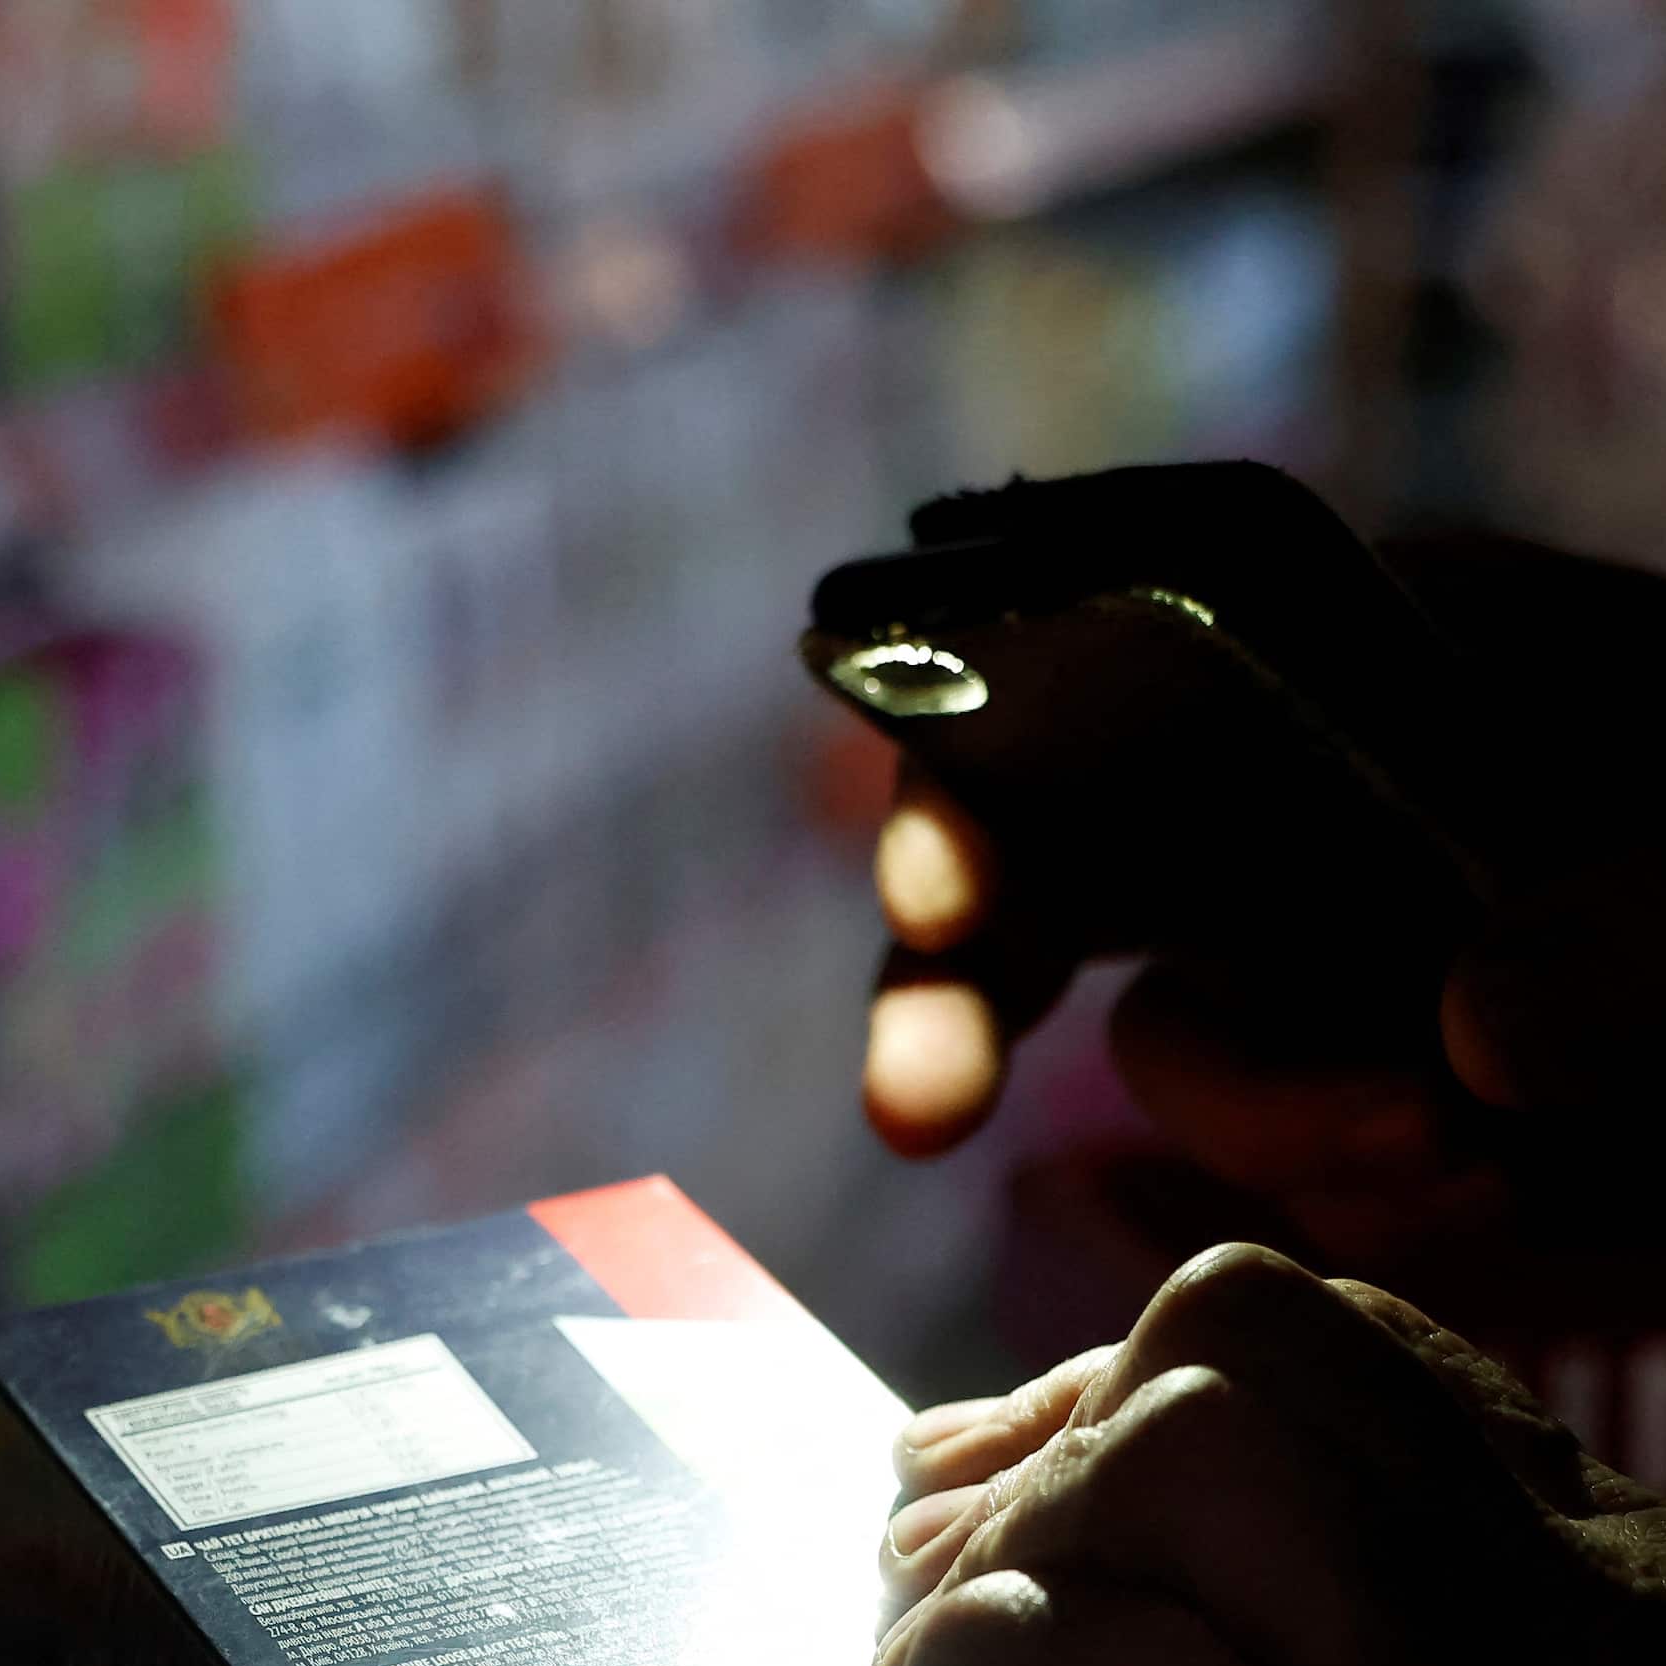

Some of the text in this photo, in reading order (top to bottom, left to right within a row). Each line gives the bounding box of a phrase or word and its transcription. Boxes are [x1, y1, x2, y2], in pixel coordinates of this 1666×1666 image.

[162, 1542, 193, 1559] UA
[245, 1601, 275, 1617] САН
[295, 1638, 345, 1659] Дніпро,
[335, 1631, 378, 1650] 49038,
[330, 1644, 374, 1664] 04128,
[365, 1635, 416, 1656] Україна,
[427, 1648, 473, 1666] LOOSE
[465, 1640, 511, 1659] BLACK
